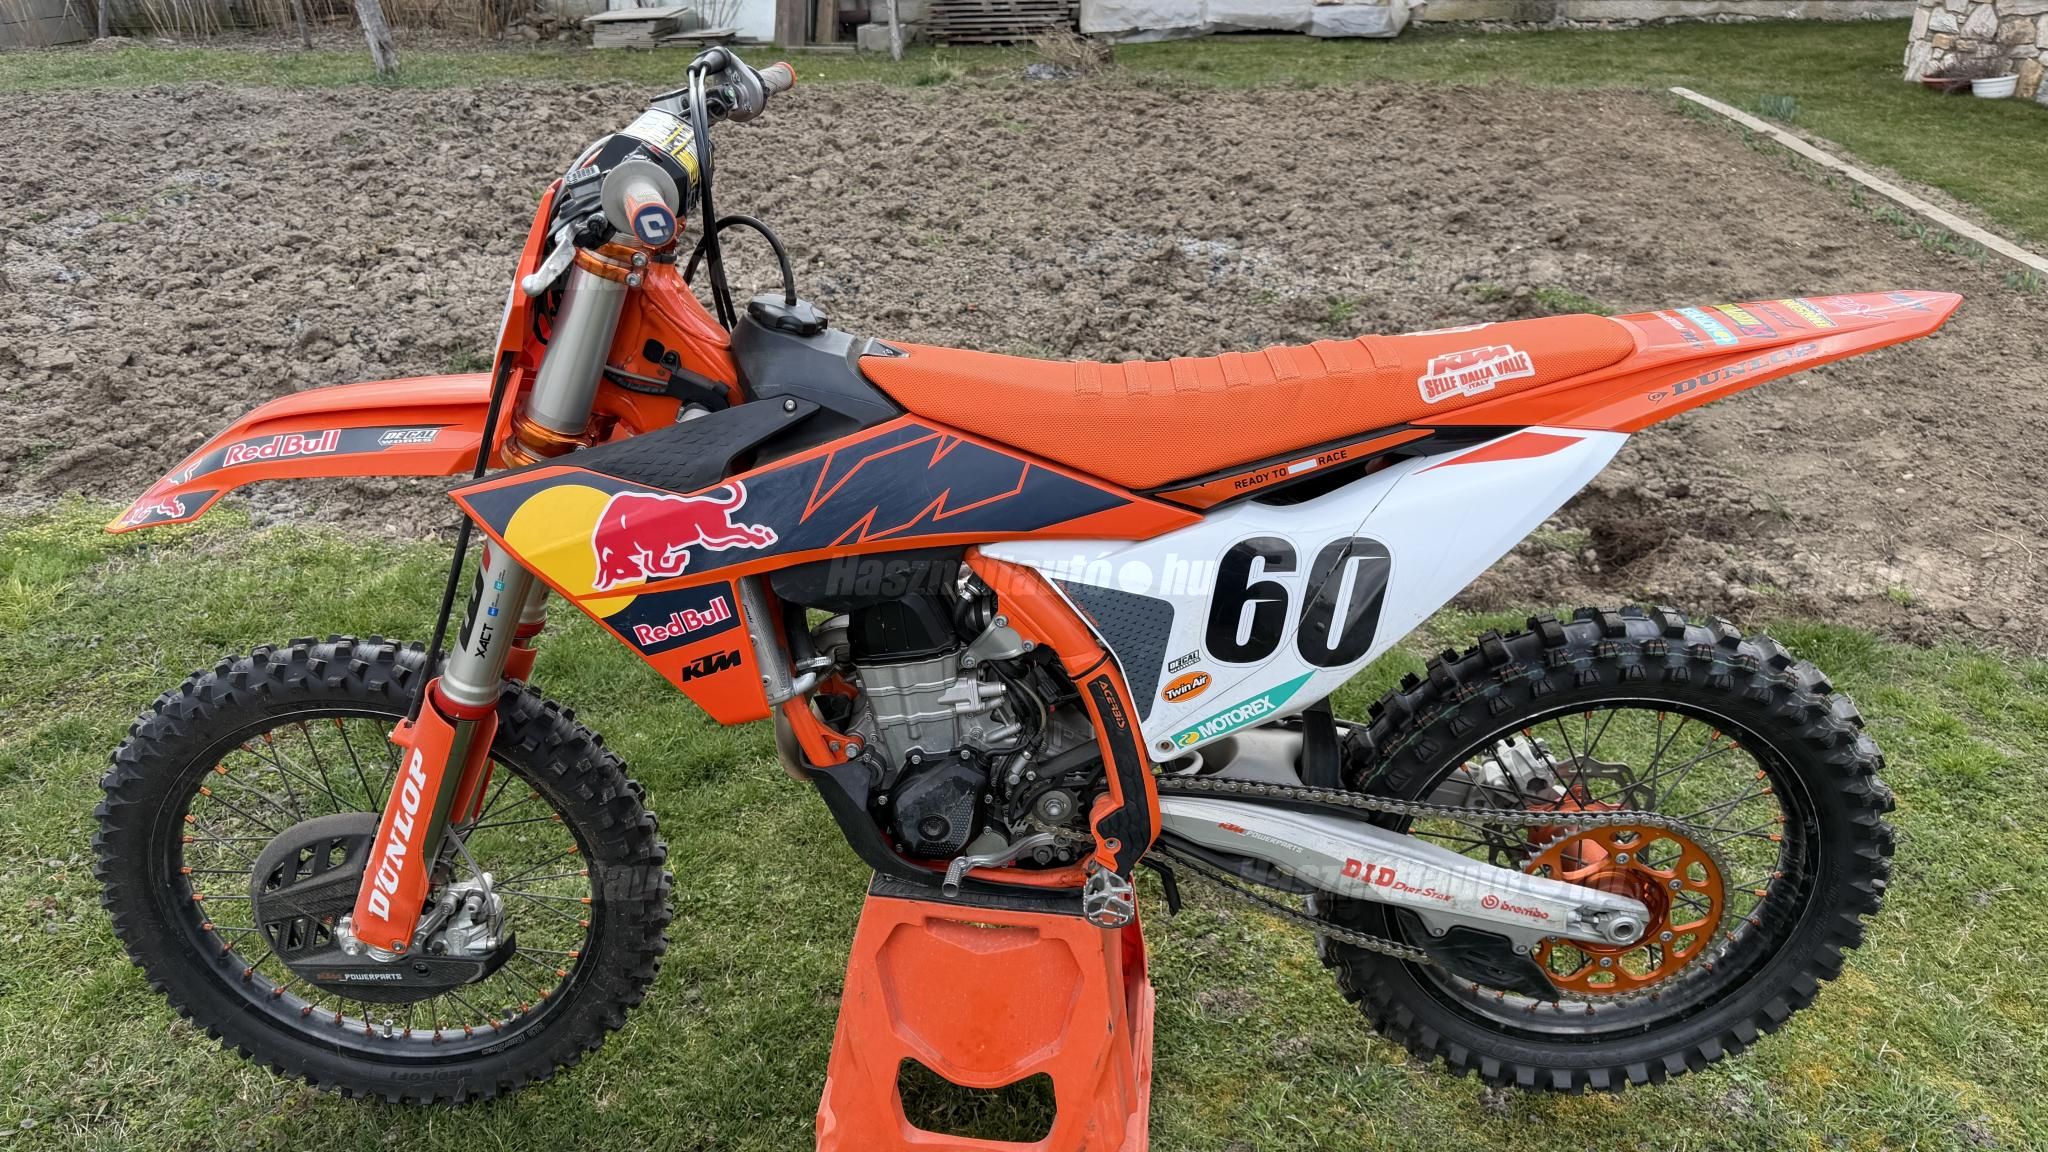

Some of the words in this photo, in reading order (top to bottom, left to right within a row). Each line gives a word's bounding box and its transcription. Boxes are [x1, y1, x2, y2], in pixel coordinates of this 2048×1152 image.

[1424, 375, 1457, 399] SELLE
[1459, 366, 1494, 385] DALLA
[1494, 354, 1529, 375] VALLE
[1468, 379, 1490, 390] ITALY
[1672, 343, 1817, 397] DUNLOP
[223, 436, 284, 468] Red
[281, 429, 342, 458] Bull
[1234, 472, 1270, 489] READY
[1273, 468, 1287, 479] TO
[1318, 450, 1348, 465] RACE
[633, 612, 686, 646] Red
[680, 596, 731, 632] Bull
[1205, 536, 1391, 667] 60
[475, 623, 494, 659] XACT
[682, 650, 742, 682] KTM
[1165, 684, 1192, 701] Twin
[1191, 675, 1209, 689] Air
[1198, 695, 1276, 738] MOTOREX
[367, 748, 427, 922] DUNLOP
[1500, 901, 1549, 919] brembo
